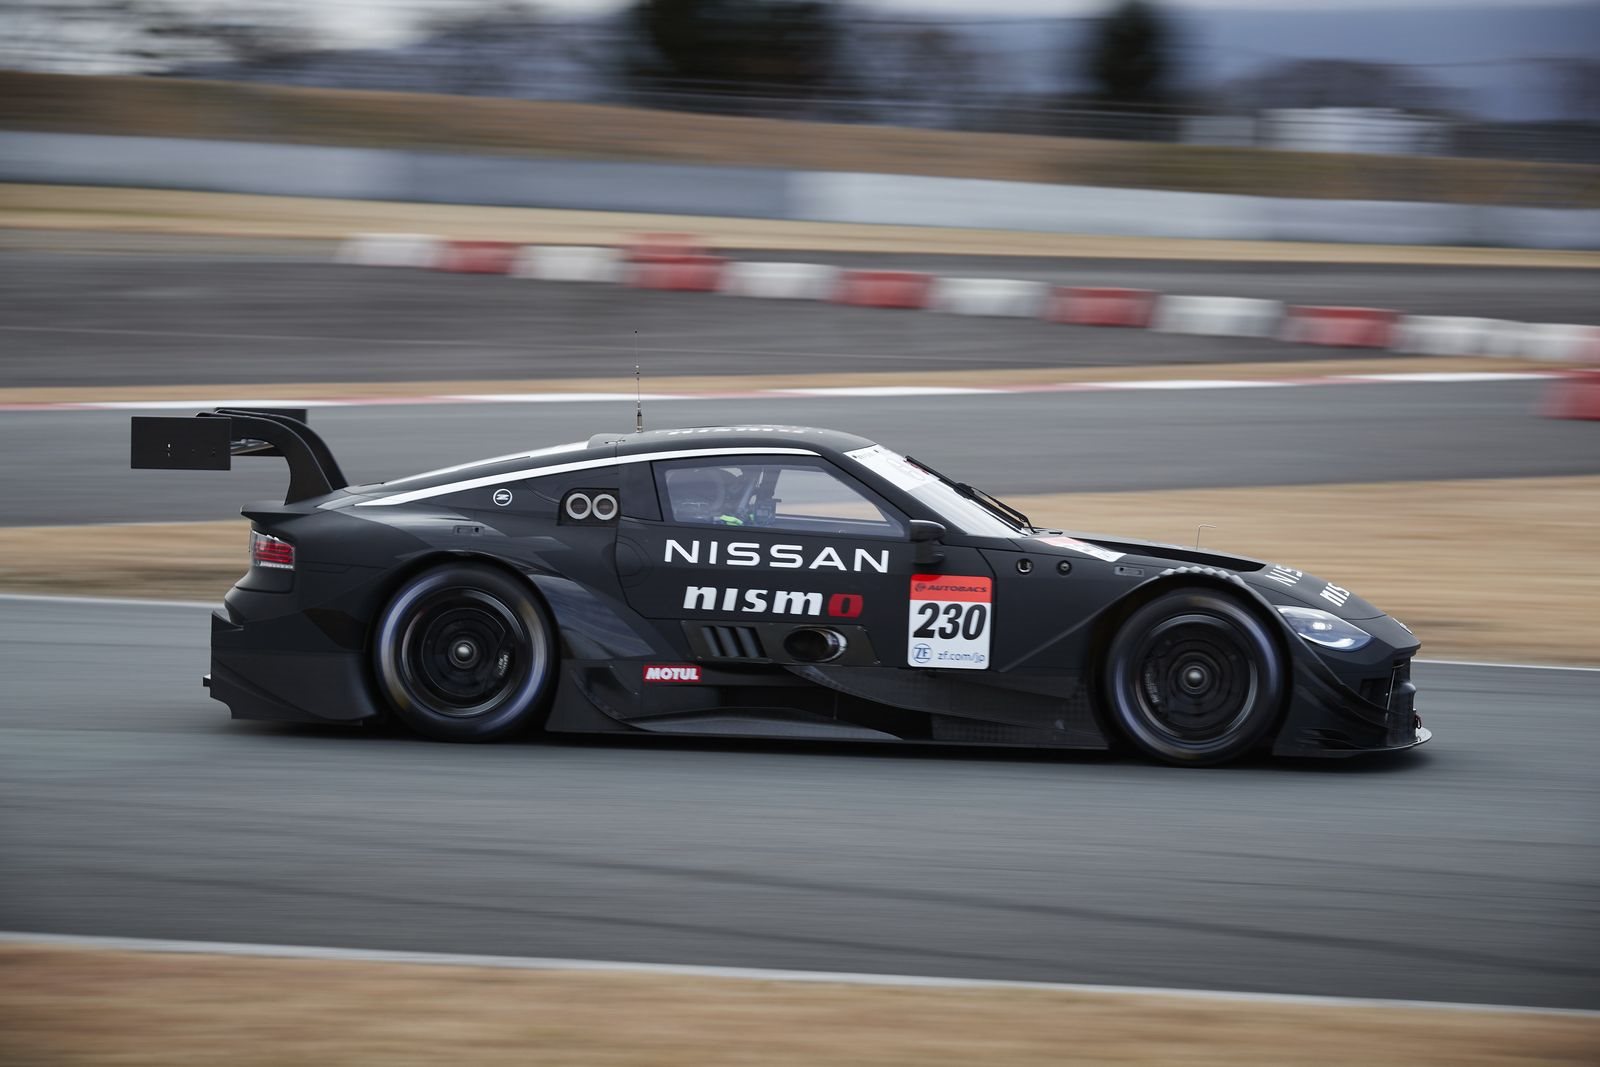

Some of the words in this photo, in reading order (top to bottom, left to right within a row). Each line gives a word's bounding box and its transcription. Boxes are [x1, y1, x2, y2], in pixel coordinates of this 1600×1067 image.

[664, 539, 890, 574] NISSAN
[927, 585, 987, 593] AUTOBACS
[913, 602, 987, 640] 230
[938, 651, 985, 663] zf.com/jp
[645, 667, 699, 680] MOTUL
